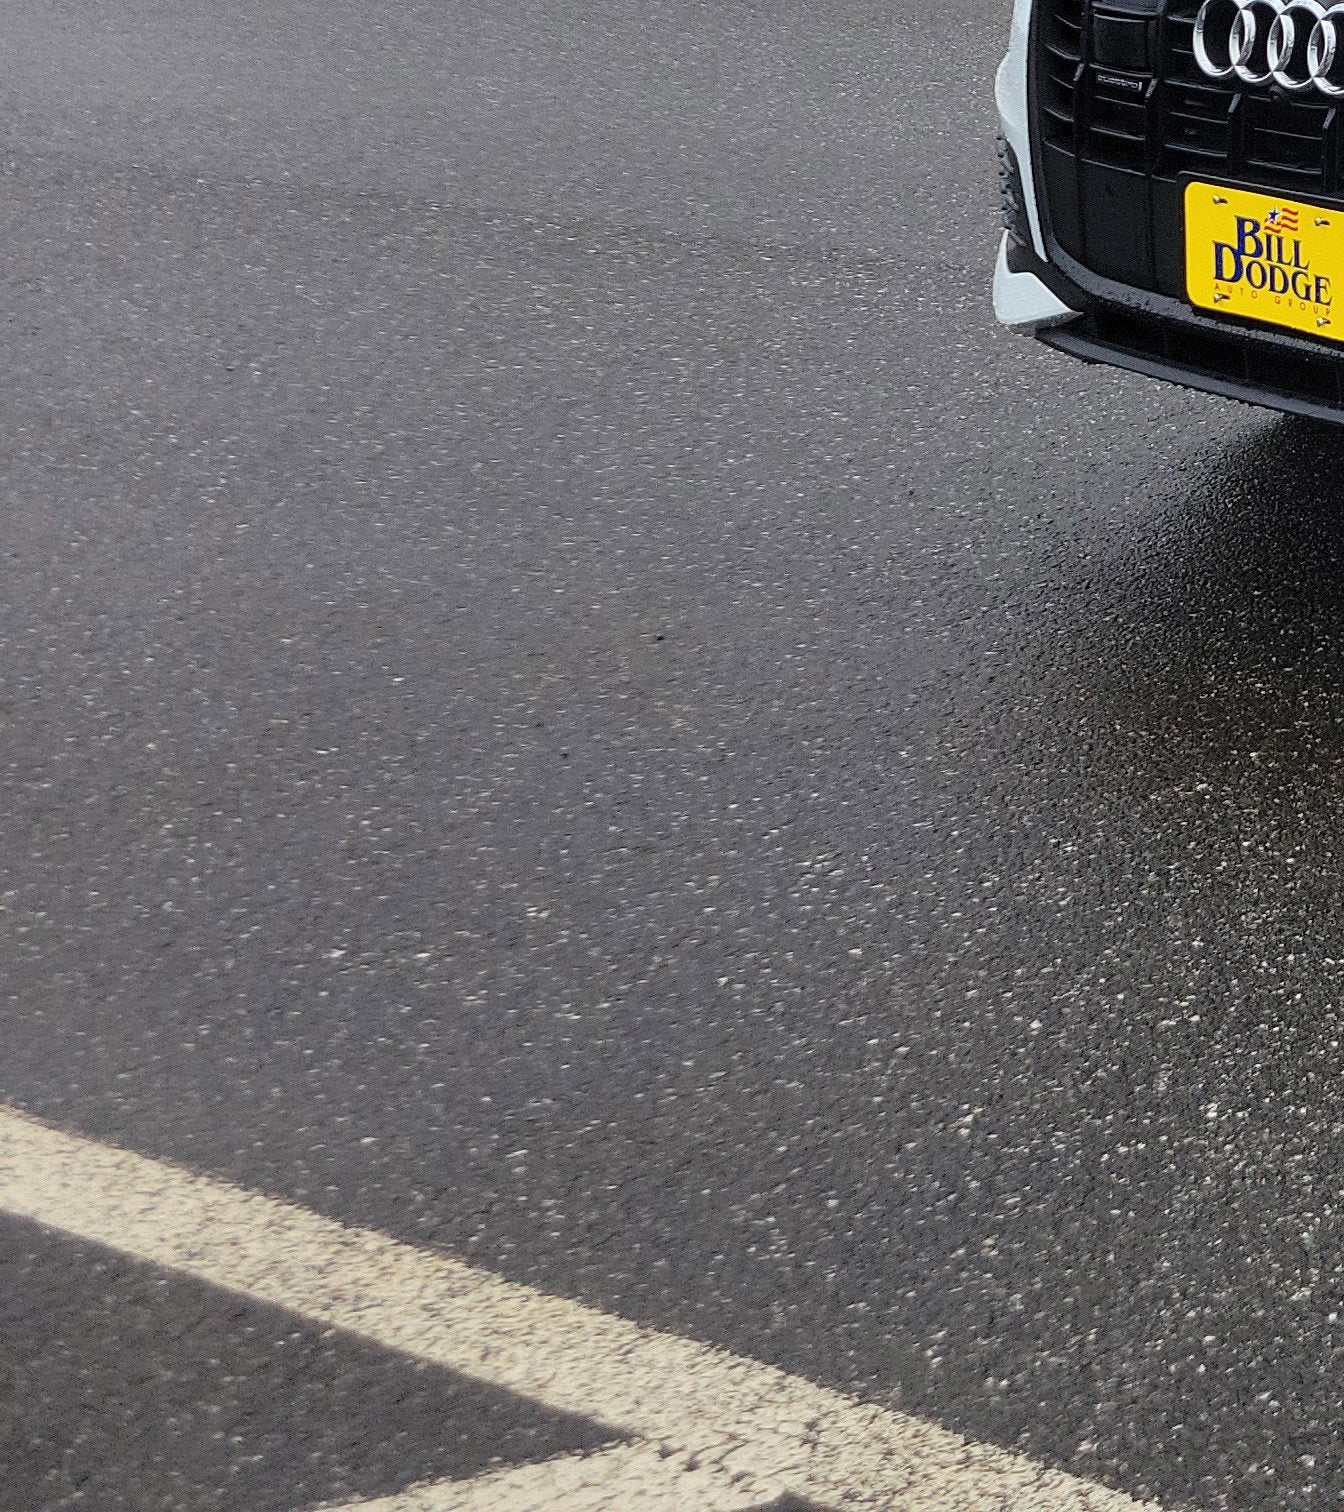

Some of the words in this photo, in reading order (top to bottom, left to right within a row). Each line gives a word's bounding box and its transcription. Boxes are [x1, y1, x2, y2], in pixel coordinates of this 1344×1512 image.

[1235, 215, 1310, 271] BILL
[1212, 240, 1333, 306] DODGE
[1214, 283, 1258, 300] AUTO
[1274, 295, 1331, 317] GROUP
